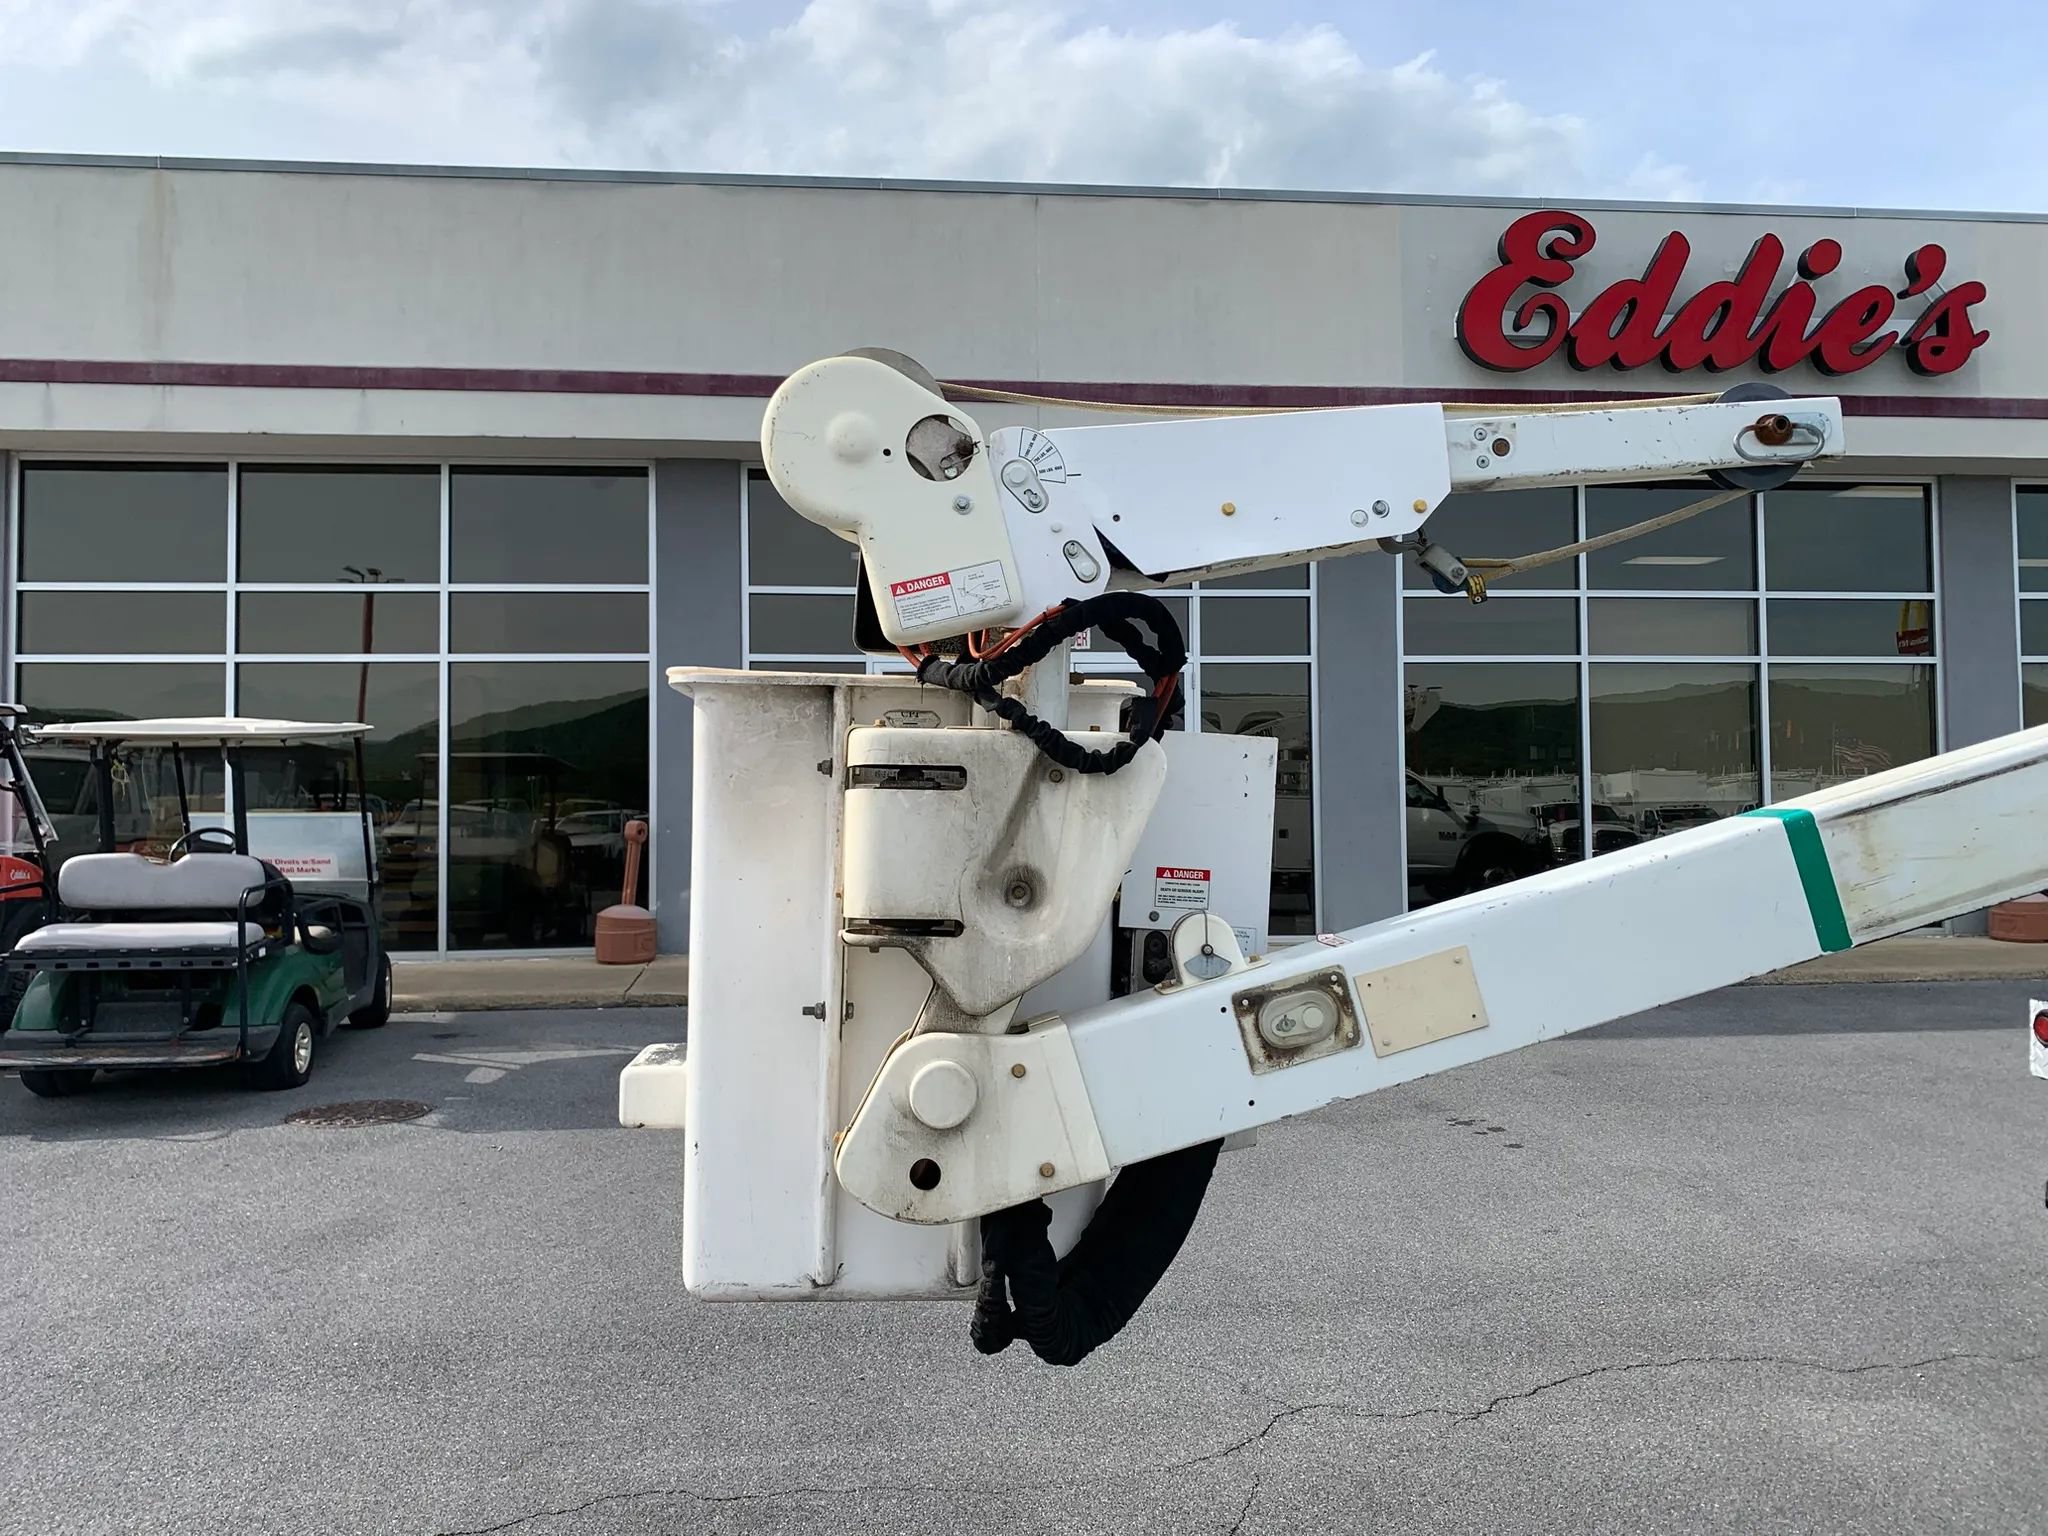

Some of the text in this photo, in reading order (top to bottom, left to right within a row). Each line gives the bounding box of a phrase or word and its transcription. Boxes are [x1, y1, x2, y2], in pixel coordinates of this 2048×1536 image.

[1456, 210, 1990, 374] Eddie's
[906, 575, 946, 592] DANGER
[1173, 869, 1204, 880] DANGER
